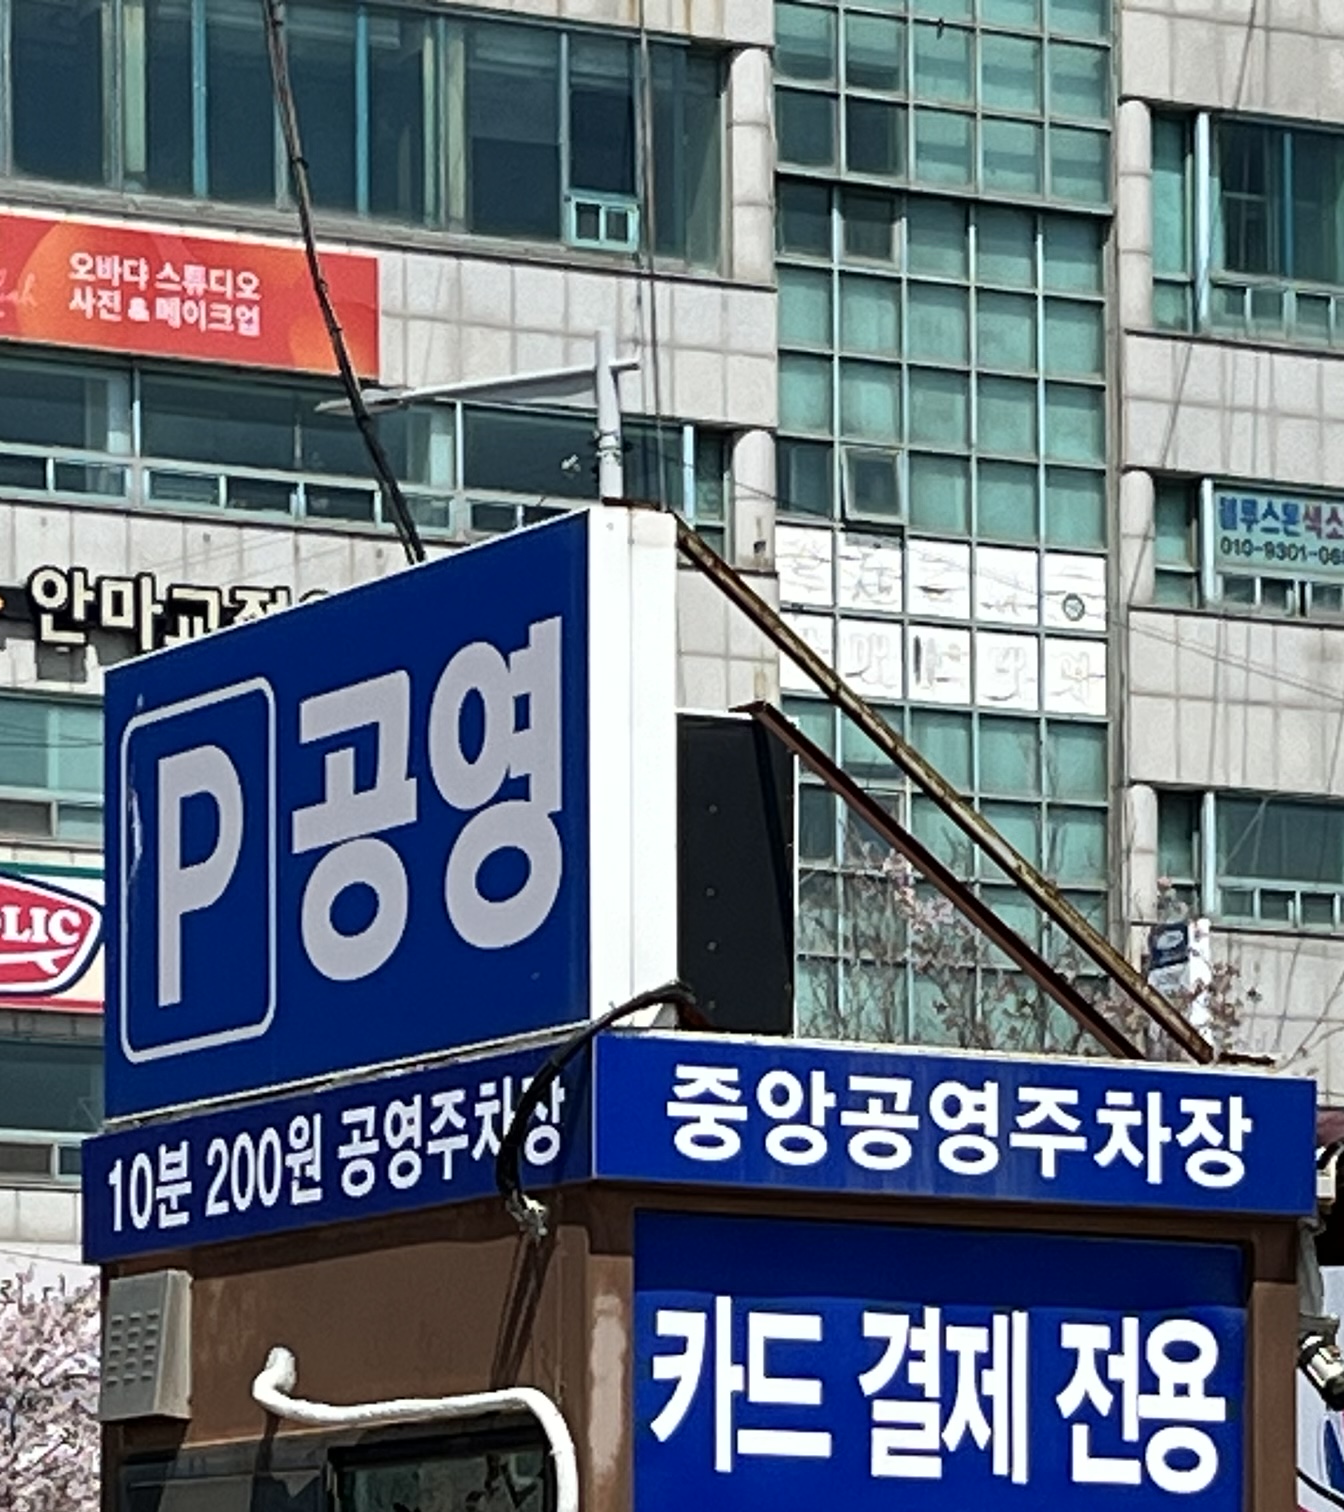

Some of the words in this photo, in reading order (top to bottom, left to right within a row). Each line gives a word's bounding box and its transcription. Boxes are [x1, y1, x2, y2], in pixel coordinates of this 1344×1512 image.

[68, 285, 123, 321] 사진
[127, 296, 151, 323] &
[154, 295, 261, 337] 메이크업
[154, 261, 263, 302] 스튜디오
[28, 566, 316, 652] 안마교
[157, 743, 244, 1008] P
[291, 615, 563, 979] 공영
[107, 1139, 193, 1232] 10분
[204, 1112, 323, 1218] 200원
[337, 1074, 566, 1198] 공영주차장
[666, 1063, 1254, 1190] 중앙공영주차장
[649, 1294, 834, 1474] 카드
[857, 1306, 1030, 1486] 결제
[1056, 1315, 1227, 1495] 전용
